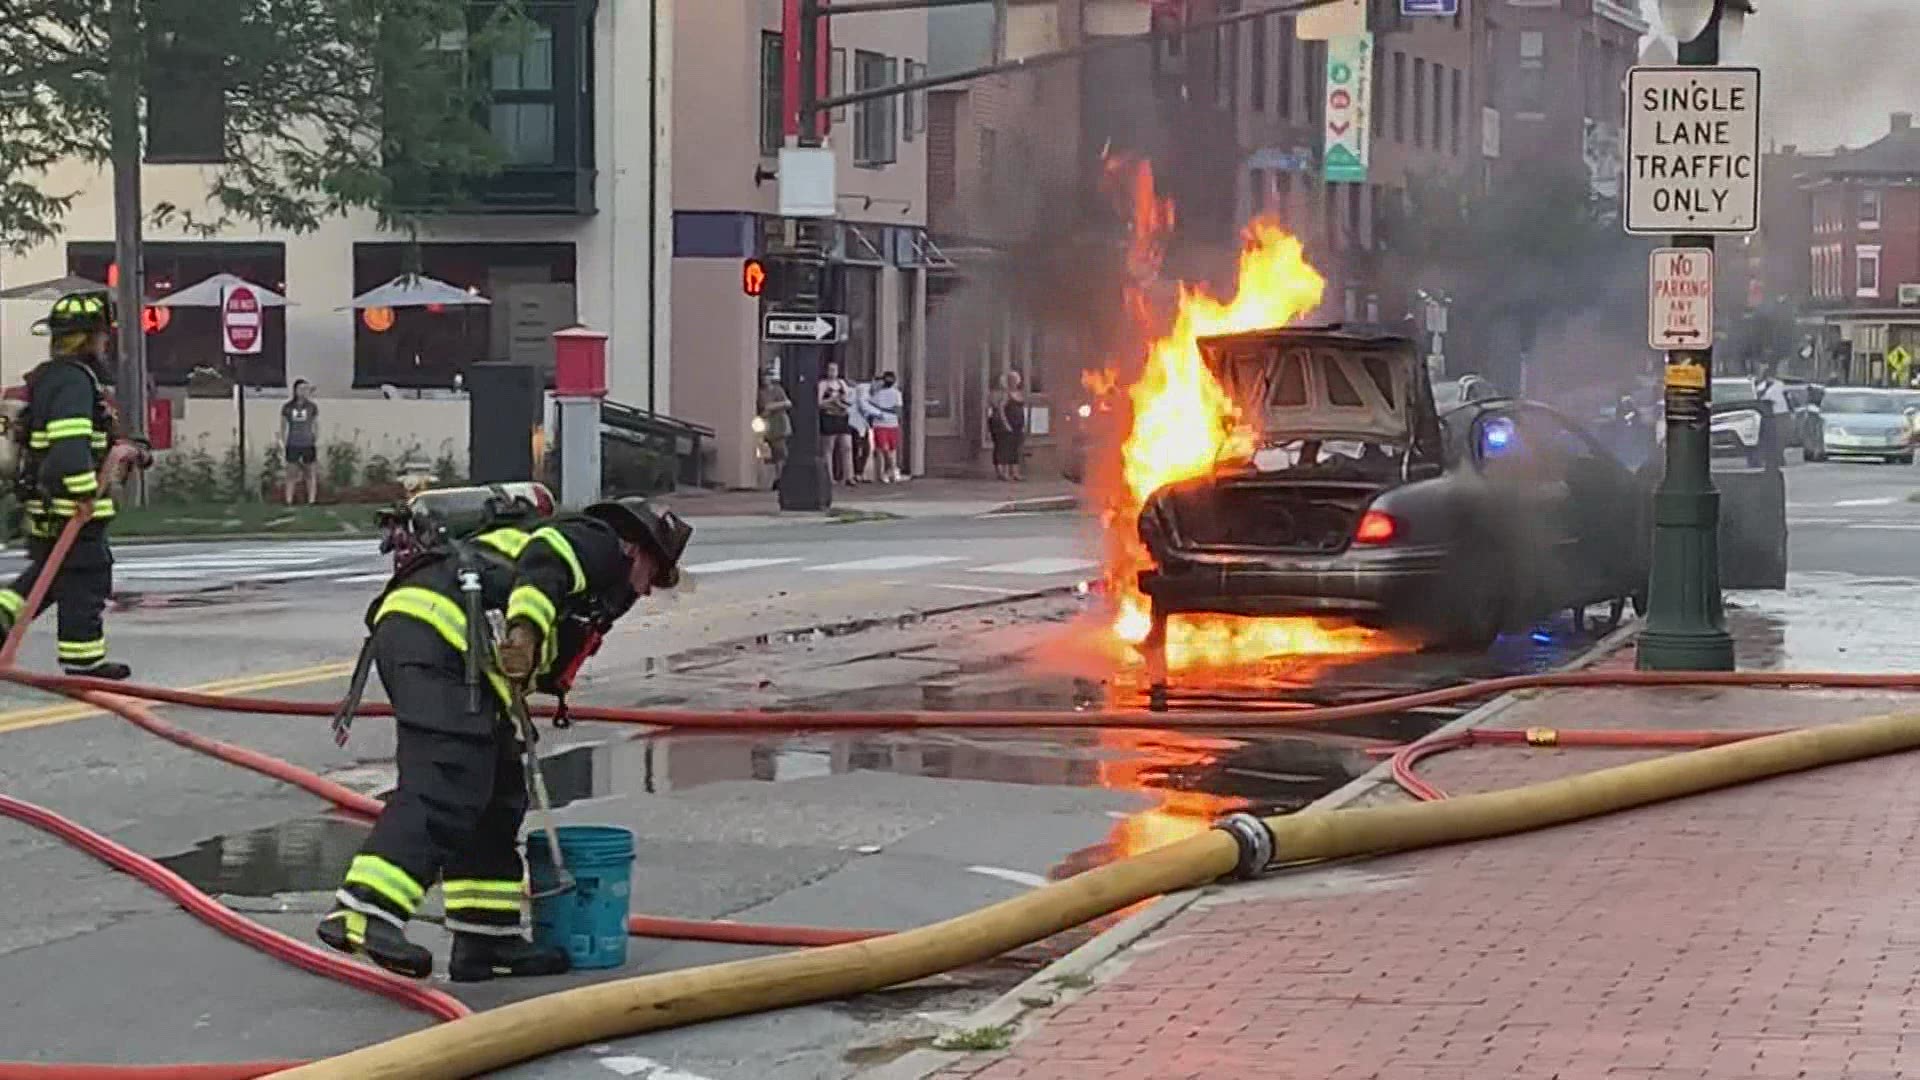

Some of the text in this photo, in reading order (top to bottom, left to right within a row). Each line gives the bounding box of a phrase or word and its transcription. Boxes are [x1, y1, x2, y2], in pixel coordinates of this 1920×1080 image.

[1643, 87, 1745, 112] SINGLE
[1655, 121, 1730, 145] LANE
[1635, 155, 1751, 179] TRAFFIC
[1653, 188, 1729, 213] ONLY
[1670, 258, 1693, 276] NO
[1655, 280, 1711, 297] PARKING
[1669, 301, 1692, 313] ANY
